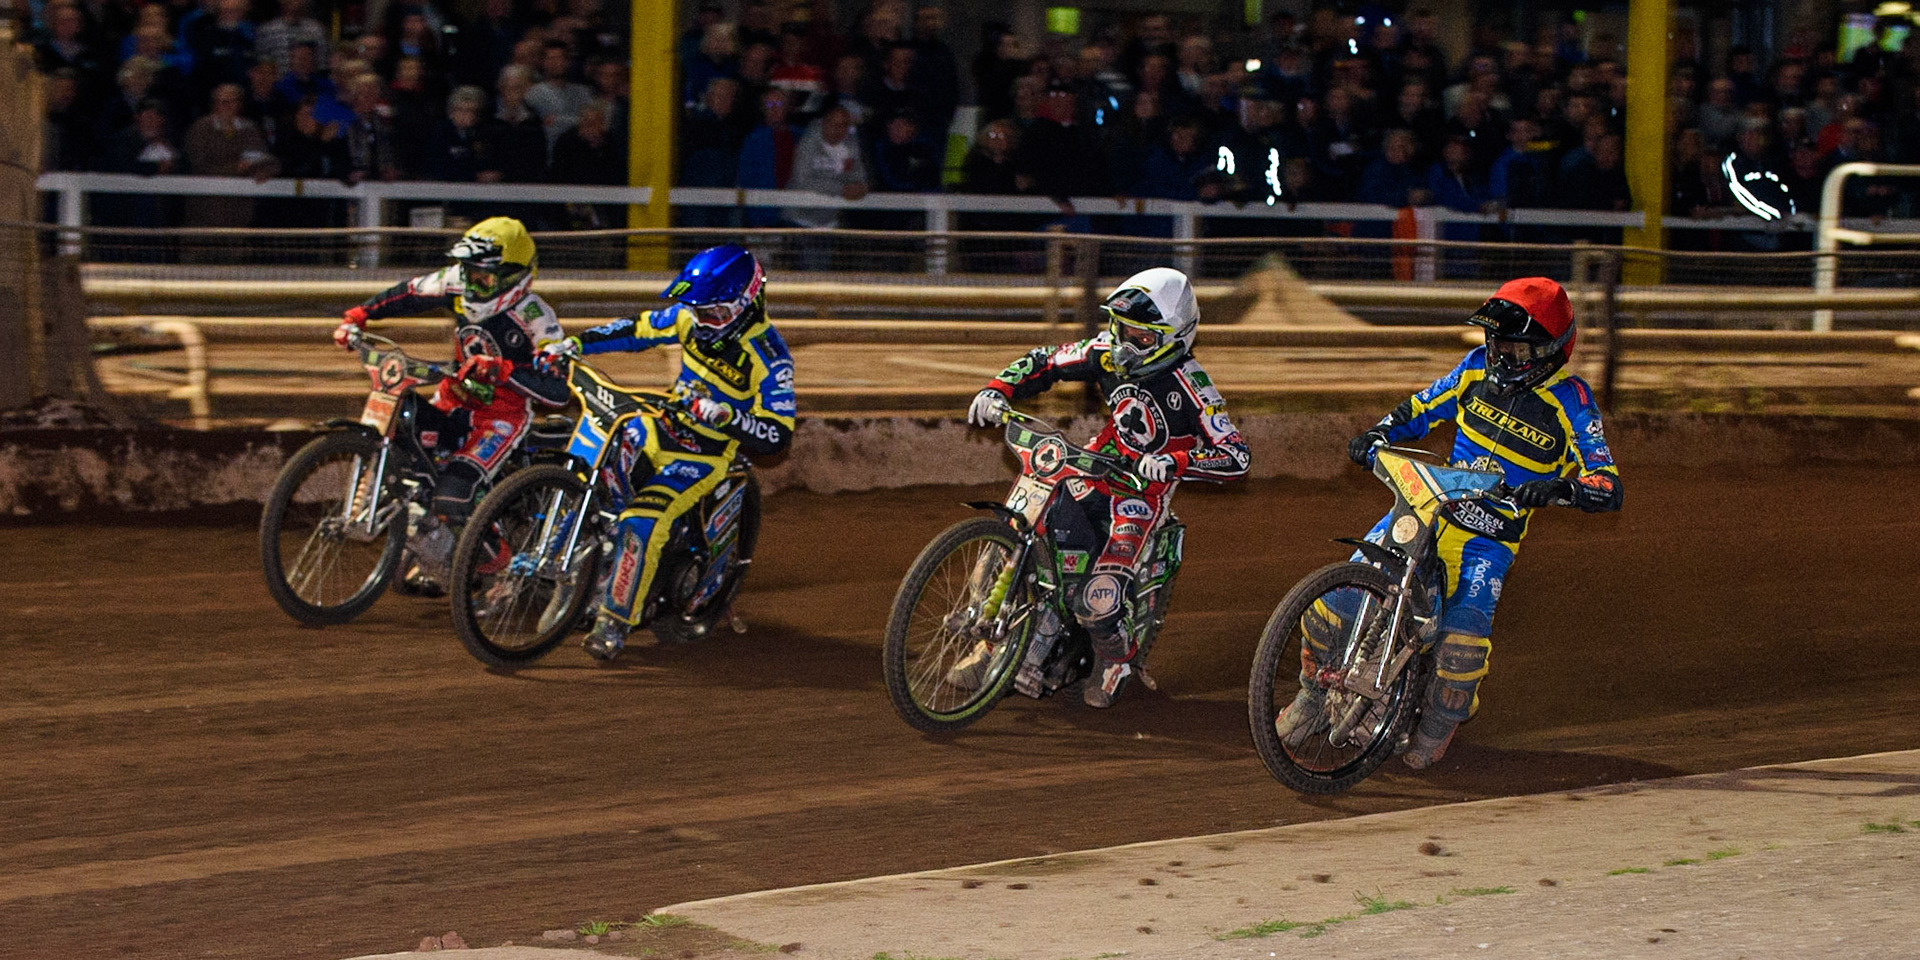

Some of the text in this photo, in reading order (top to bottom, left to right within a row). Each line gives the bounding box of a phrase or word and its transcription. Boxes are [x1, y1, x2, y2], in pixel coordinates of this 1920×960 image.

[1470, 400, 1551, 447] TRU PLANT
[1455, 509, 1496, 534] ACING
[1090, 588, 1115, 600] ATPI
[1467, 557, 1492, 598] PlanCon
